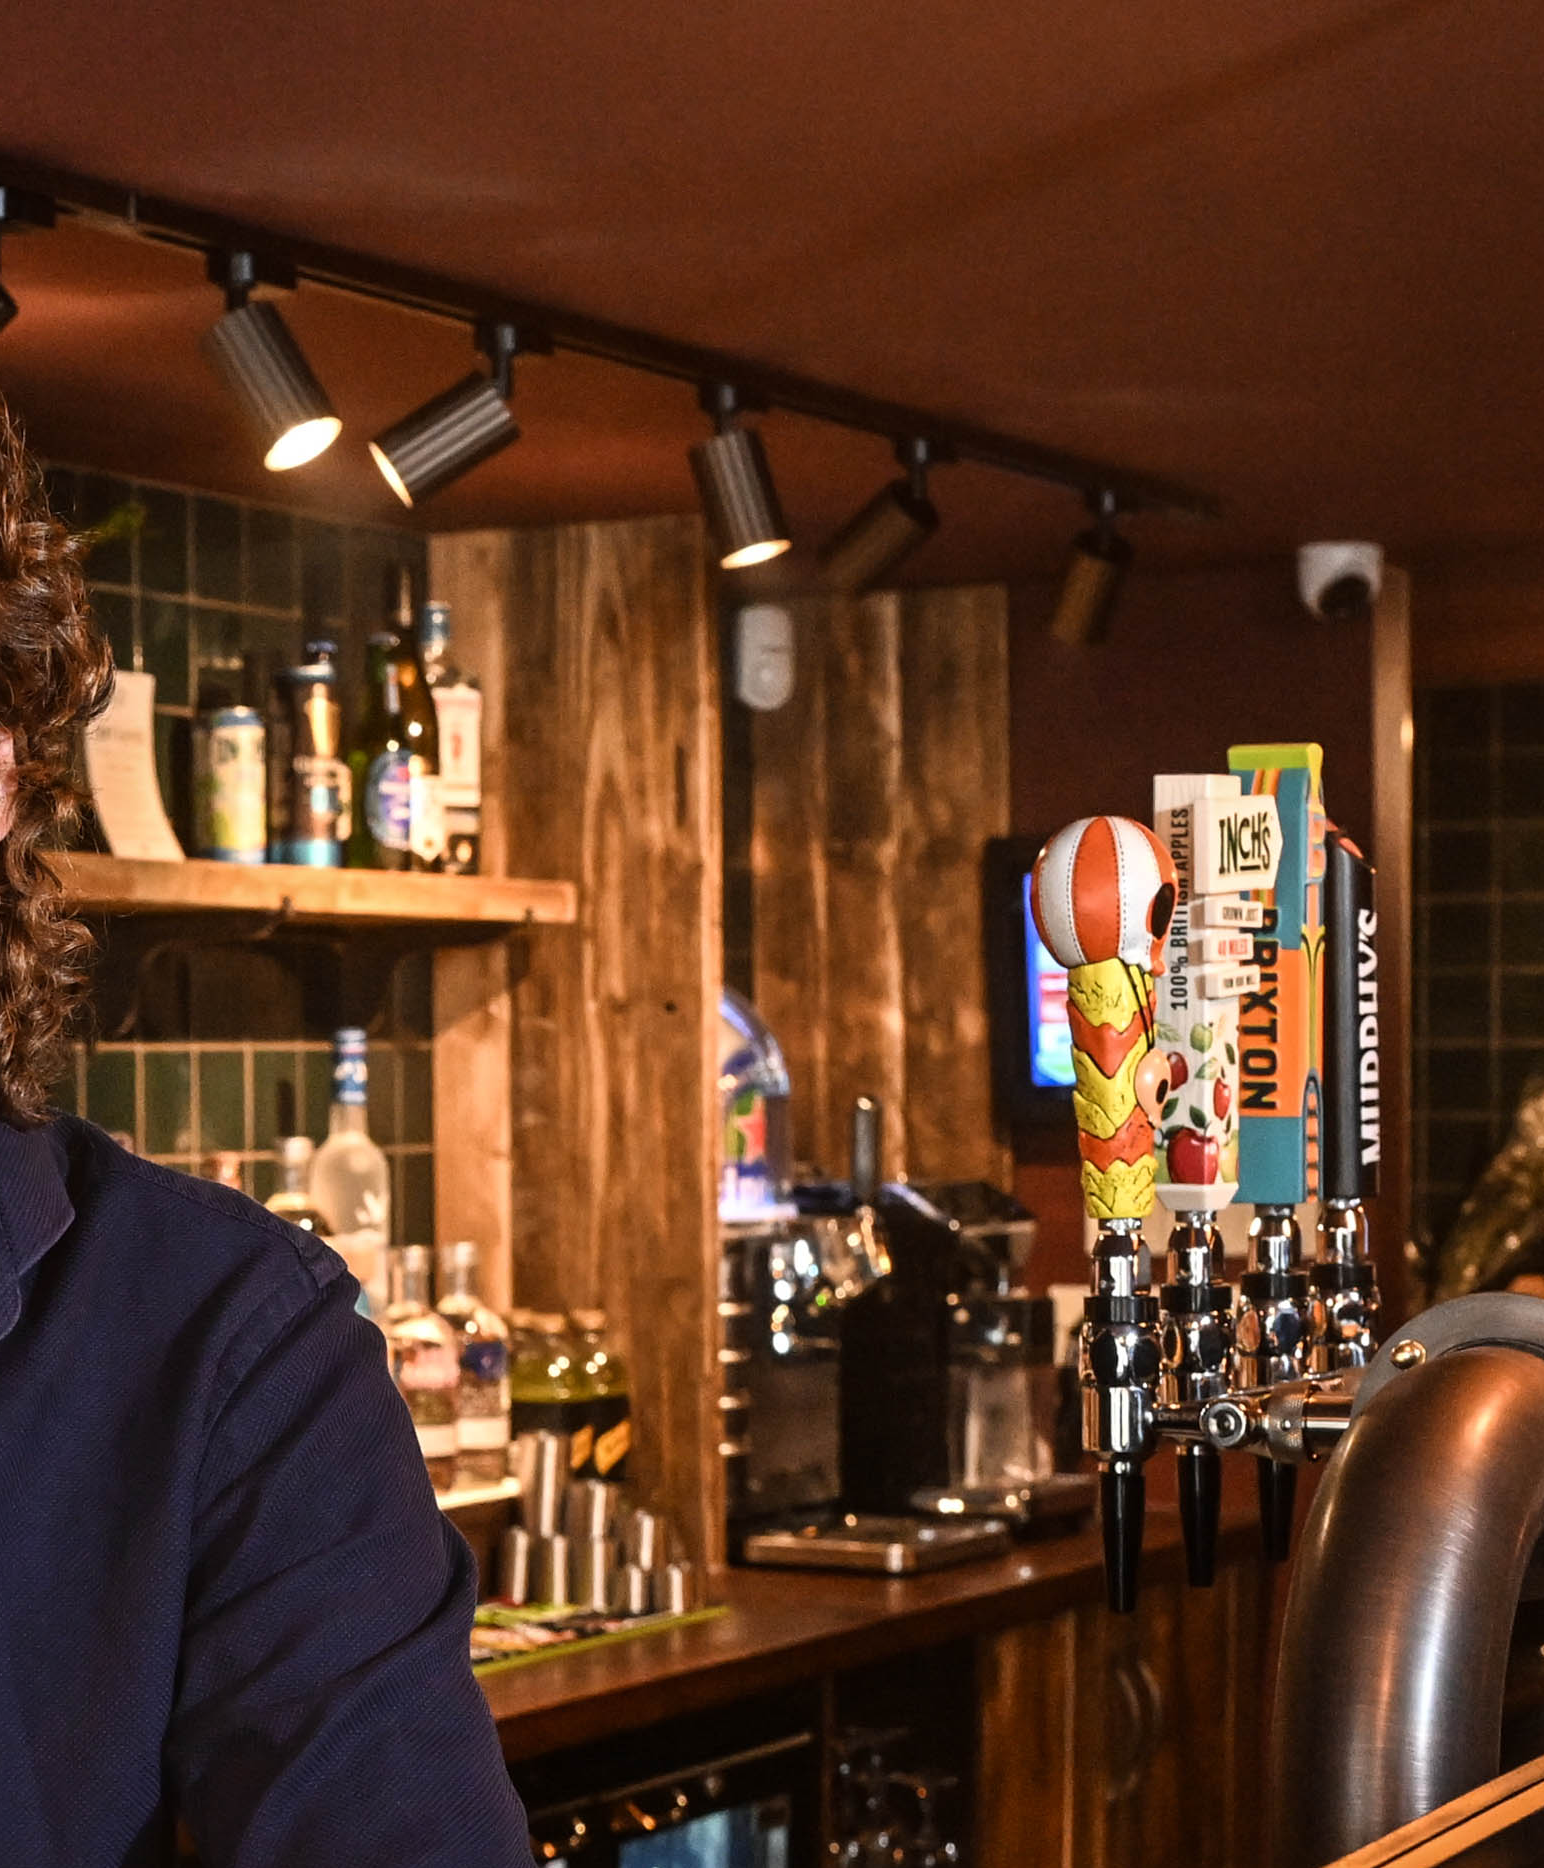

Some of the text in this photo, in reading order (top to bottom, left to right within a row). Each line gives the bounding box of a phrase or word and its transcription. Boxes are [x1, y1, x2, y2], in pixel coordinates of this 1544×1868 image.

[1170, 807, 1189, 872] APPLES
[1218, 811, 1271, 876] INCH'S
[1170, 956, 1189, 1011] 100%
